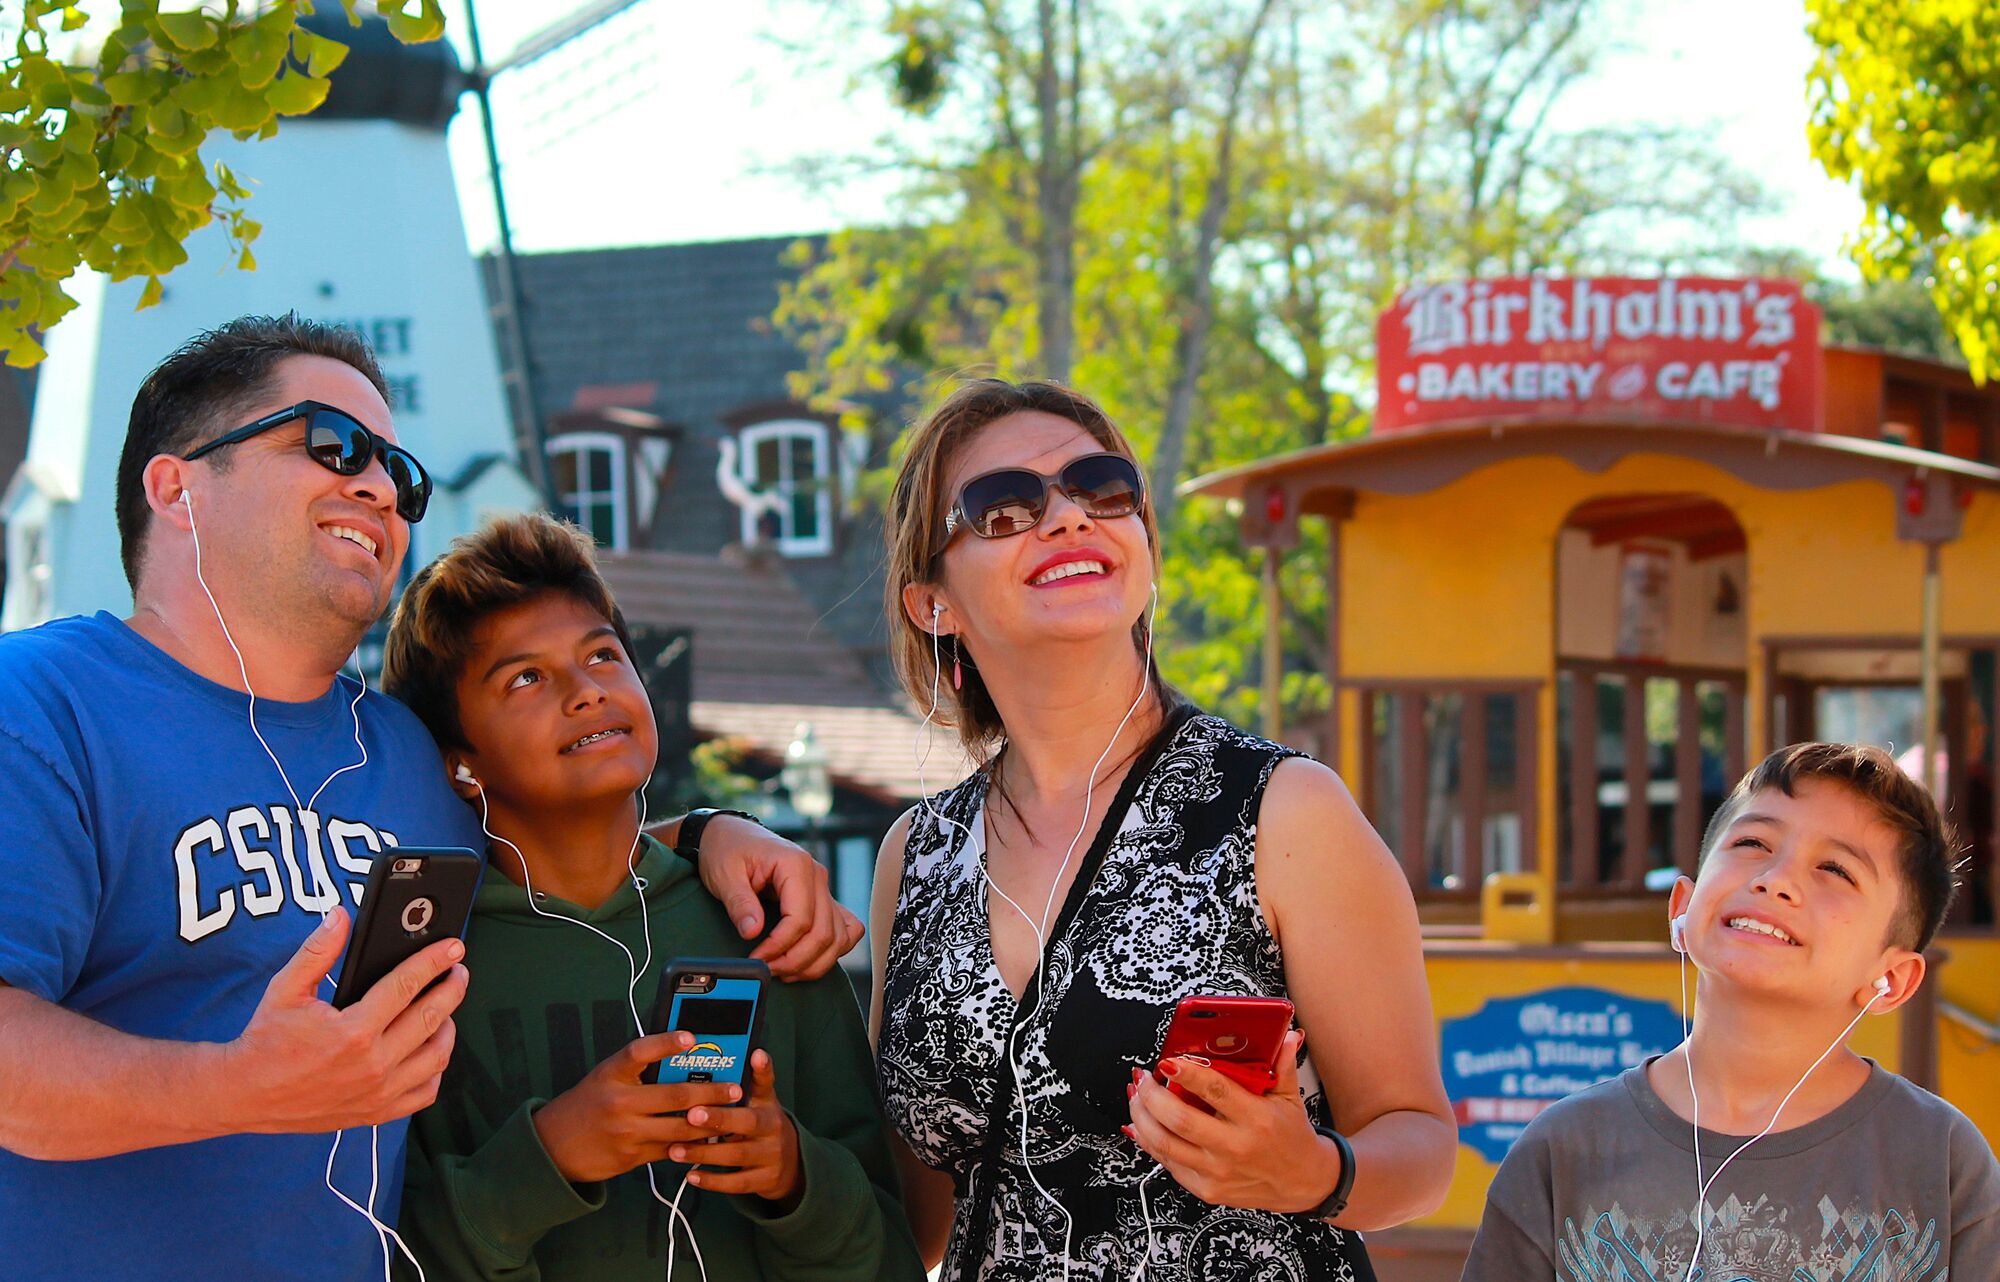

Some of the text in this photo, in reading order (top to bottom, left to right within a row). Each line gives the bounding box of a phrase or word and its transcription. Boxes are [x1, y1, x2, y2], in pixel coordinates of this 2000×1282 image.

[1402, 278, 1796, 353] Birkholm's
[1417, 361, 1601, 400] BAKERY
[172, 804, 402, 944] CSUS
[1518, 1002, 1634, 1036] Olsen's
[669, 1054, 737, 1069] CHARGERS
